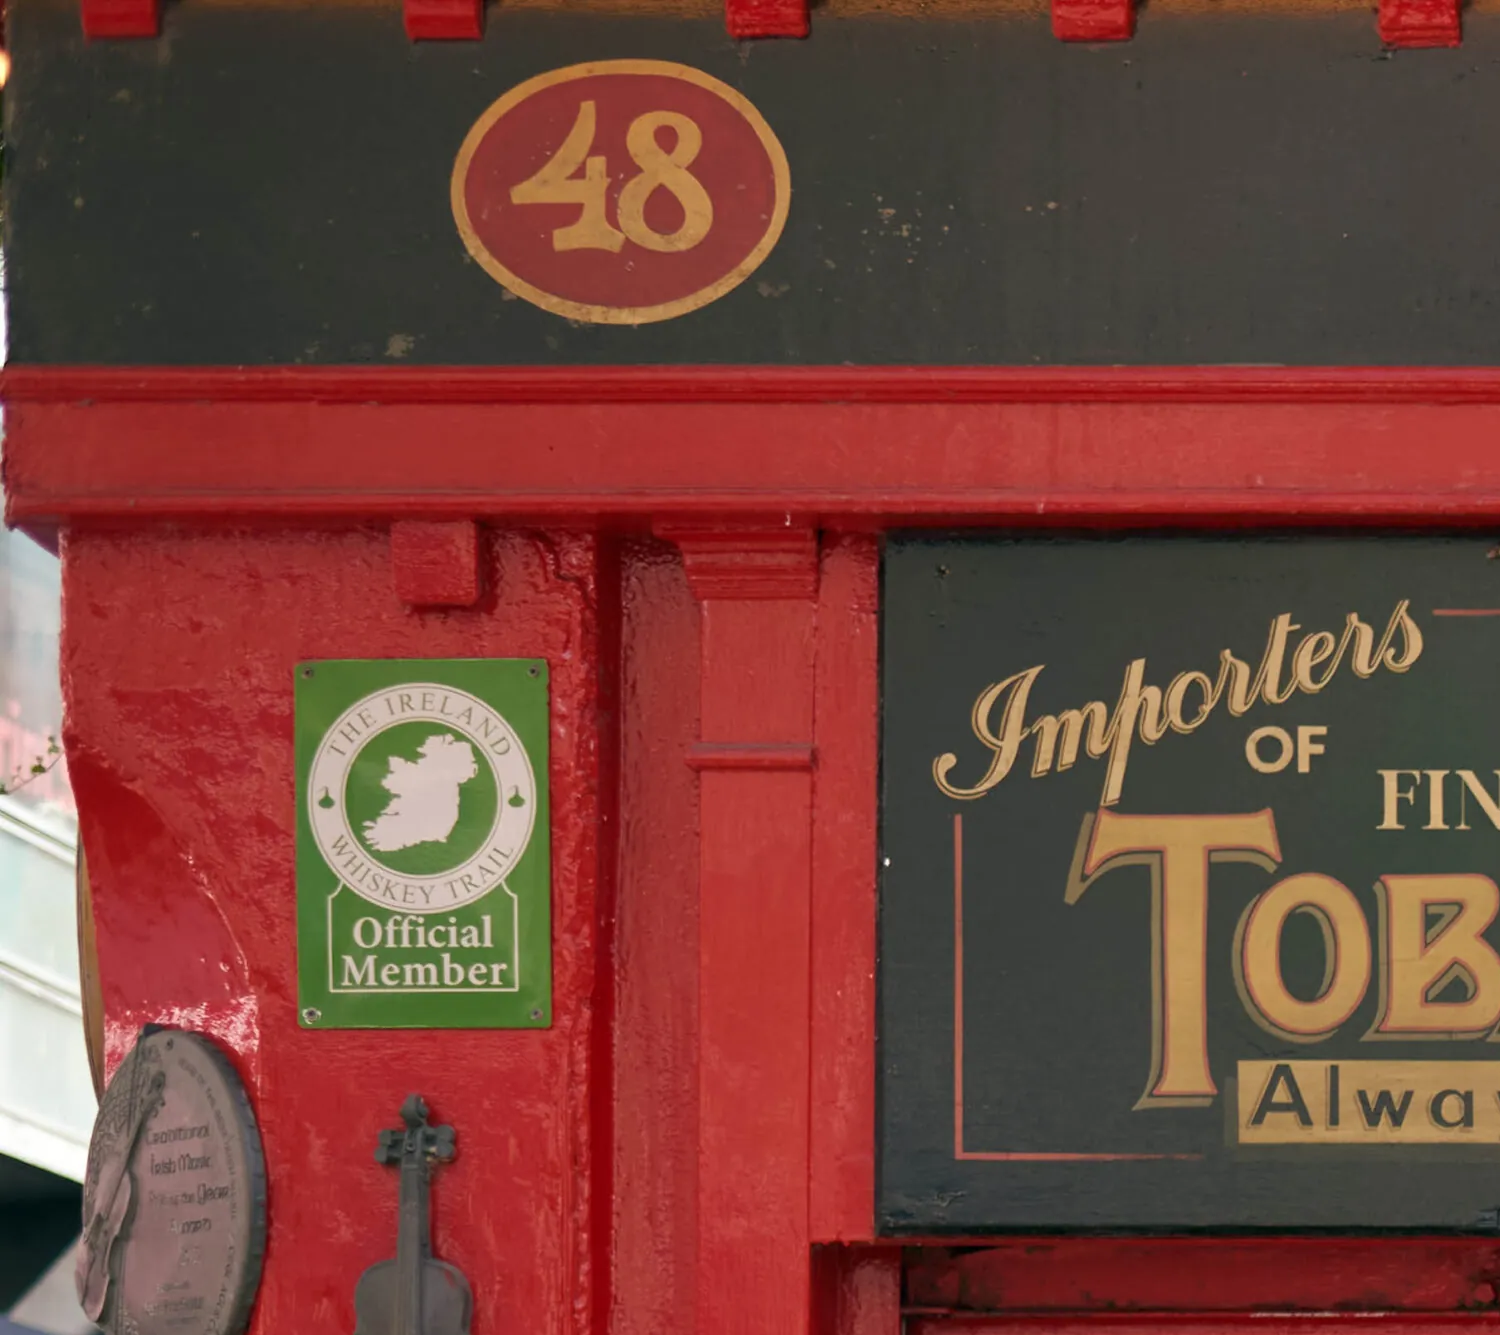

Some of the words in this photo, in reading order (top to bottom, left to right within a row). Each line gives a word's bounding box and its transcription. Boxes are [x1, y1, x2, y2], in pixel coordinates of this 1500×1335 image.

[509, 100, 714, 254] 48
[386, 692, 512, 758] IRELAND
[932, 597, 1424, 807] Importers
[1245, 725, 1330, 778] OF
[330, 834, 435, 905] WHISKEY
[448, 844, 514, 900] TRAIL
[353, 915, 494, 949] Official
[341, 953, 508, 987] Member
